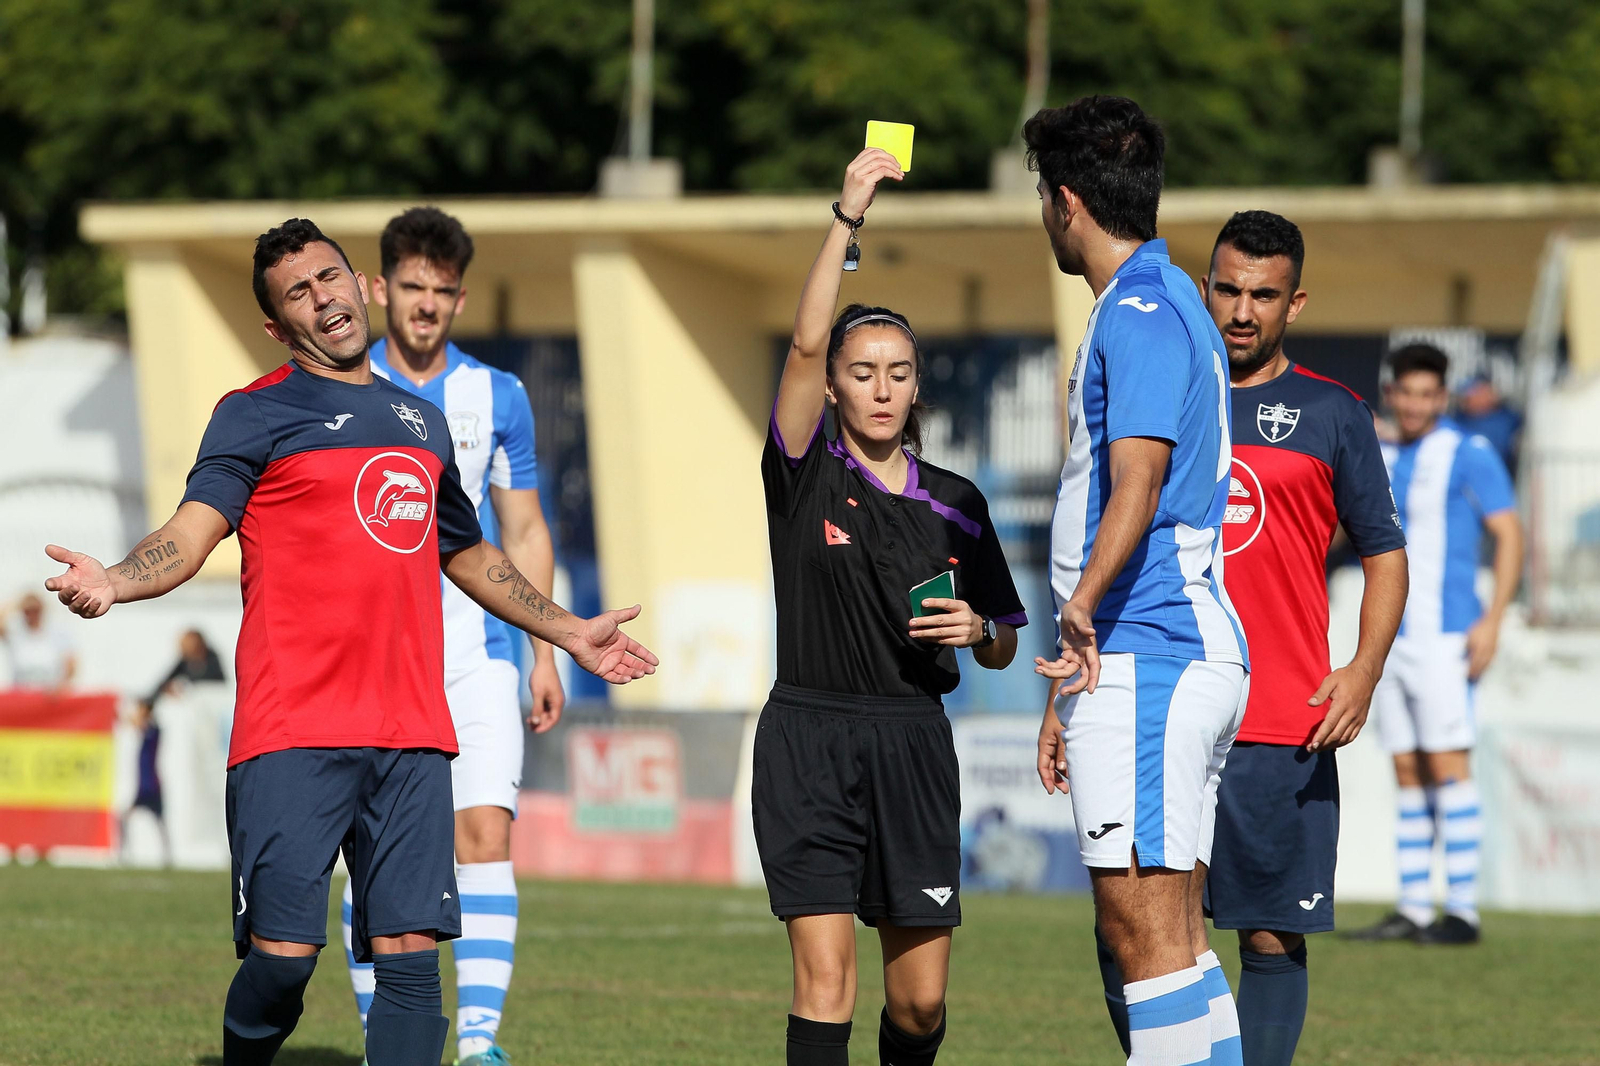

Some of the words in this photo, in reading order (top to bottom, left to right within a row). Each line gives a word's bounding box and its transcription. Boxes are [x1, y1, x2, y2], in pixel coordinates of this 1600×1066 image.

[389, 501, 428, 521] FRS
[1222, 504, 1255, 523] RS
[572, 737, 680, 802] MG
